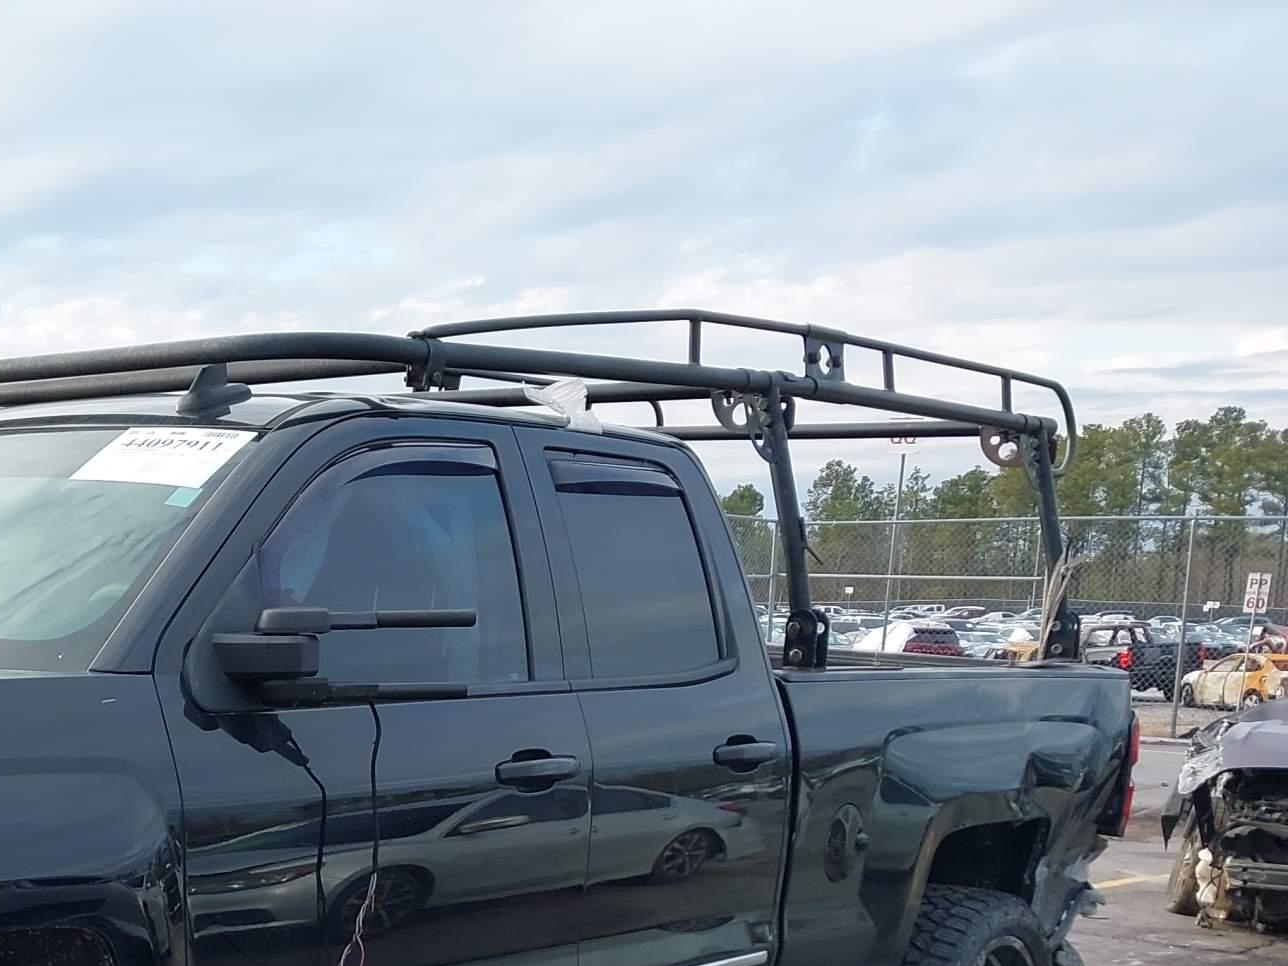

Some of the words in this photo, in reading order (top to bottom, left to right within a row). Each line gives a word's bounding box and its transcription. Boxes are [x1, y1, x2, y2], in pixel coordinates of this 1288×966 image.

[121, 438, 224, 451] 44097911
[1250, 578, 1269, 590] PP
[1247, 597, 1266, 610] 60
